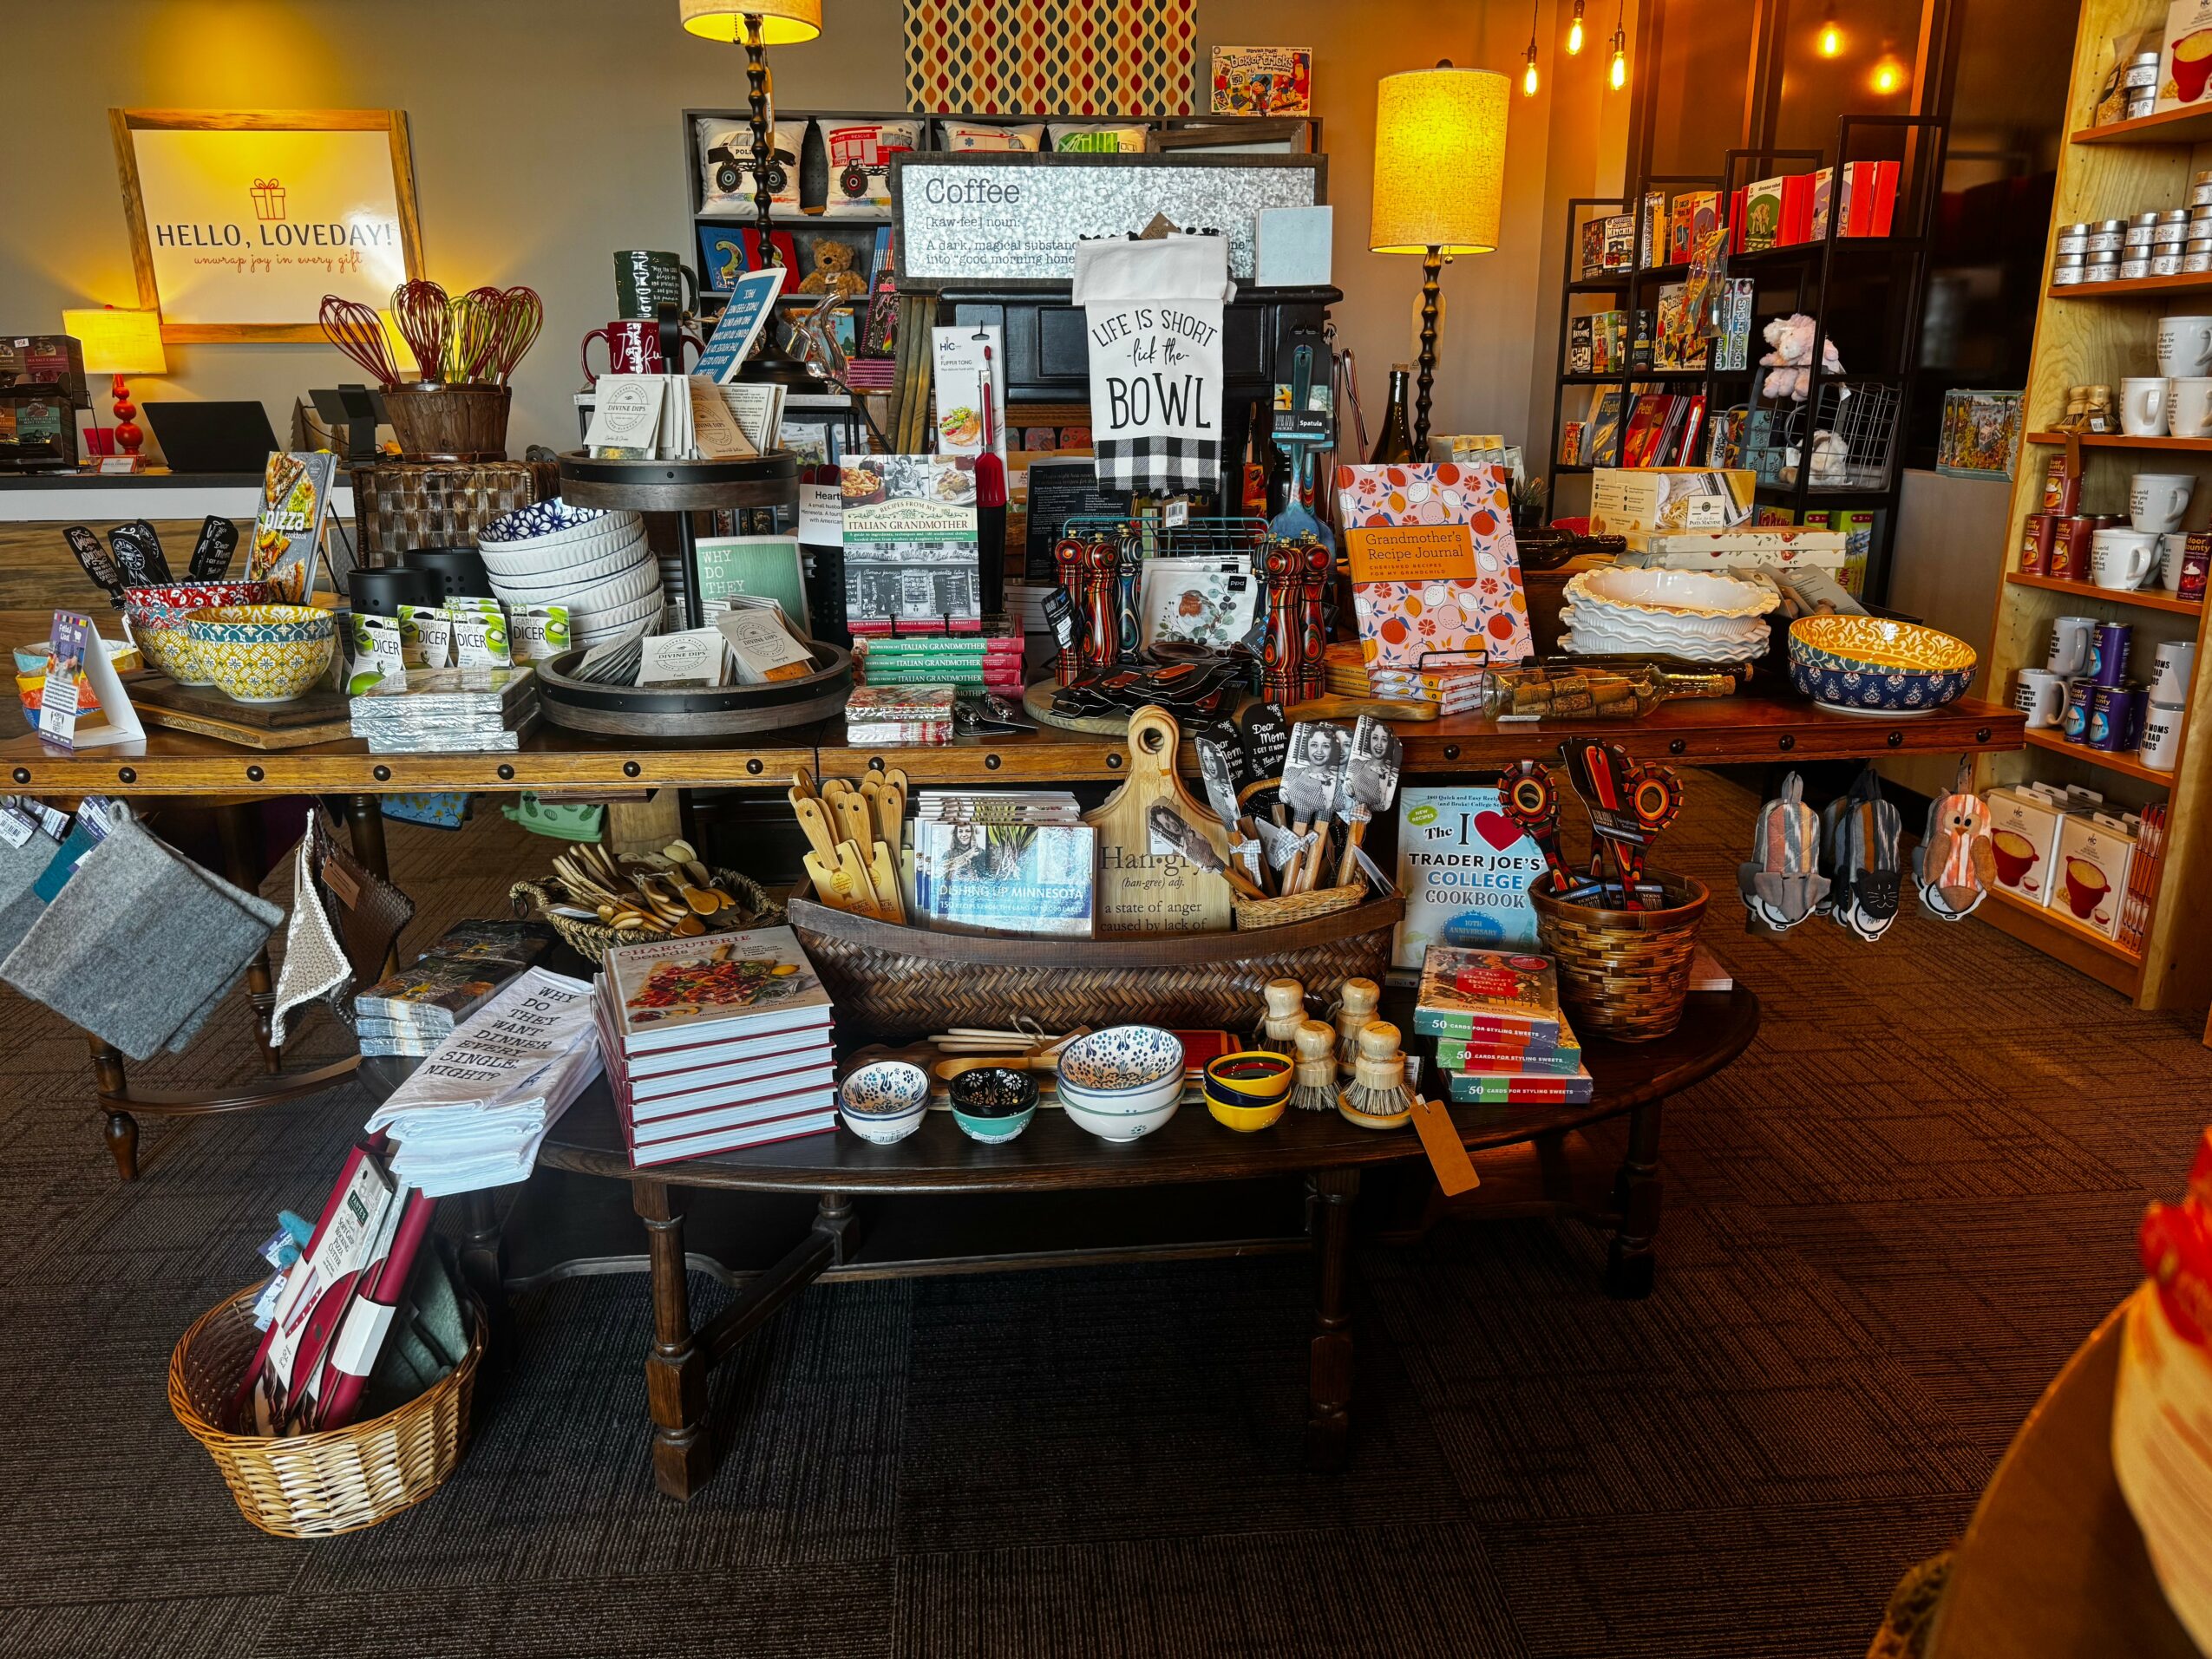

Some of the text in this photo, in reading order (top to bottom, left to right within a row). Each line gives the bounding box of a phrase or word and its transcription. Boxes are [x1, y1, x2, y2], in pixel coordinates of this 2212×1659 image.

[926, 178, 1020, 205] Coffee
[926, 216, 1021, 230] [kaw-fee] noun:
[156, 224, 393, 249] HELLO, LOVEDAY!
[1607, 227, 1633, 238] MATCHIN
[926, 239, 1077, 252] A dark, magical substanc
[193, 248, 363, 274] unwrap joy in every gift
[926, 253, 1075, 266] into morning hone
[1090, 308, 1218, 348] LIFE IS SHORT
[1106, 372, 1211, 430] BOWL
[880, 501, 904, 513] RECIPES
[263, 505, 305, 532] pizza
[848, 520, 968, 530] ITALIAN GRANDMOTHER
[285, 531, 308, 541] cookbook
[1365, 530, 1463, 545] Grandmother's
[701, 549, 732, 563] WHY
[1367, 544, 1464, 562] Recipe Journal
[704, 566, 724, 579] DO
[706, 579, 745, 594] THEY
[422, 621, 444, 633] GARLIC
[458, 624, 480, 634] GARLIC
[515, 617, 540, 627] GARLIC
[373, 630, 395, 640] GARLIC
[418, 630, 448, 646] DICER
[457, 632, 487, 649] DICER
[514, 626, 545, 642] DICER
[743, 634, 779, 646] DIVINE DIPS
[372, 638, 400, 656] DICER
[658, 651, 687, 660] DIVINE
[1252, 723, 1275, 735] Dear
[2149, 725, 2169, 735] MOMS
[1260, 731, 1287, 744] Mom.
[1257, 746, 1267, 754] GET
[1263, 754, 1284, 767] Thank You
[1411, 813, 1434, 822] RECIPES
[1424, 813, 1470, 846] The I
[1409, 853, 1484, 867] TRADER
[1122, 876, 1185, 891] (han-gree) adj.
[1427, 872, 1523, 890] COLLEGE
[939, 885, 1083, 900] DISHING UP MINNESOTA
[1425, 889, 1526, 908] COOKBOOK
[939, 900, 955, 910] 150
[1104, 900, 1202, 917] a state of anger
[1101, 918, 1207, 932] caused by lack of
[1449, 927, 1498, 937] ANNIVERSARY
[618, 934, 751, 958] CHARCUTERIE
[631, 948, 689, 962] boards
[1463, 974, 1513, 983] Dessert
[538, 986, 580, 1003] WHY
[520, 997, 550, 1011] DO
[507, 1009, 561, 1026] THEY
[1431, 1019, 1447, 1029] 50
[491, 1019, 545, 1036] WANT
[473, 1029, 553, 1049] DINNER
[440, 1050, 520, 1069] SINGLE.
[1456, 1050, 1472, 1060] 50
[422, 1065, 501, 1081] NIGHT?
[1469, 1086, 1484, 1095] 50
[350, 1194, 366, 1219] FANTE'S
[334, 1226, 350, 1252] ROCKING
[345, 1229, 355, 1245] GRIP
[332, 1238, 344, 1257] PIZZA
[328, 1244, 342, 1267] CUTTER
